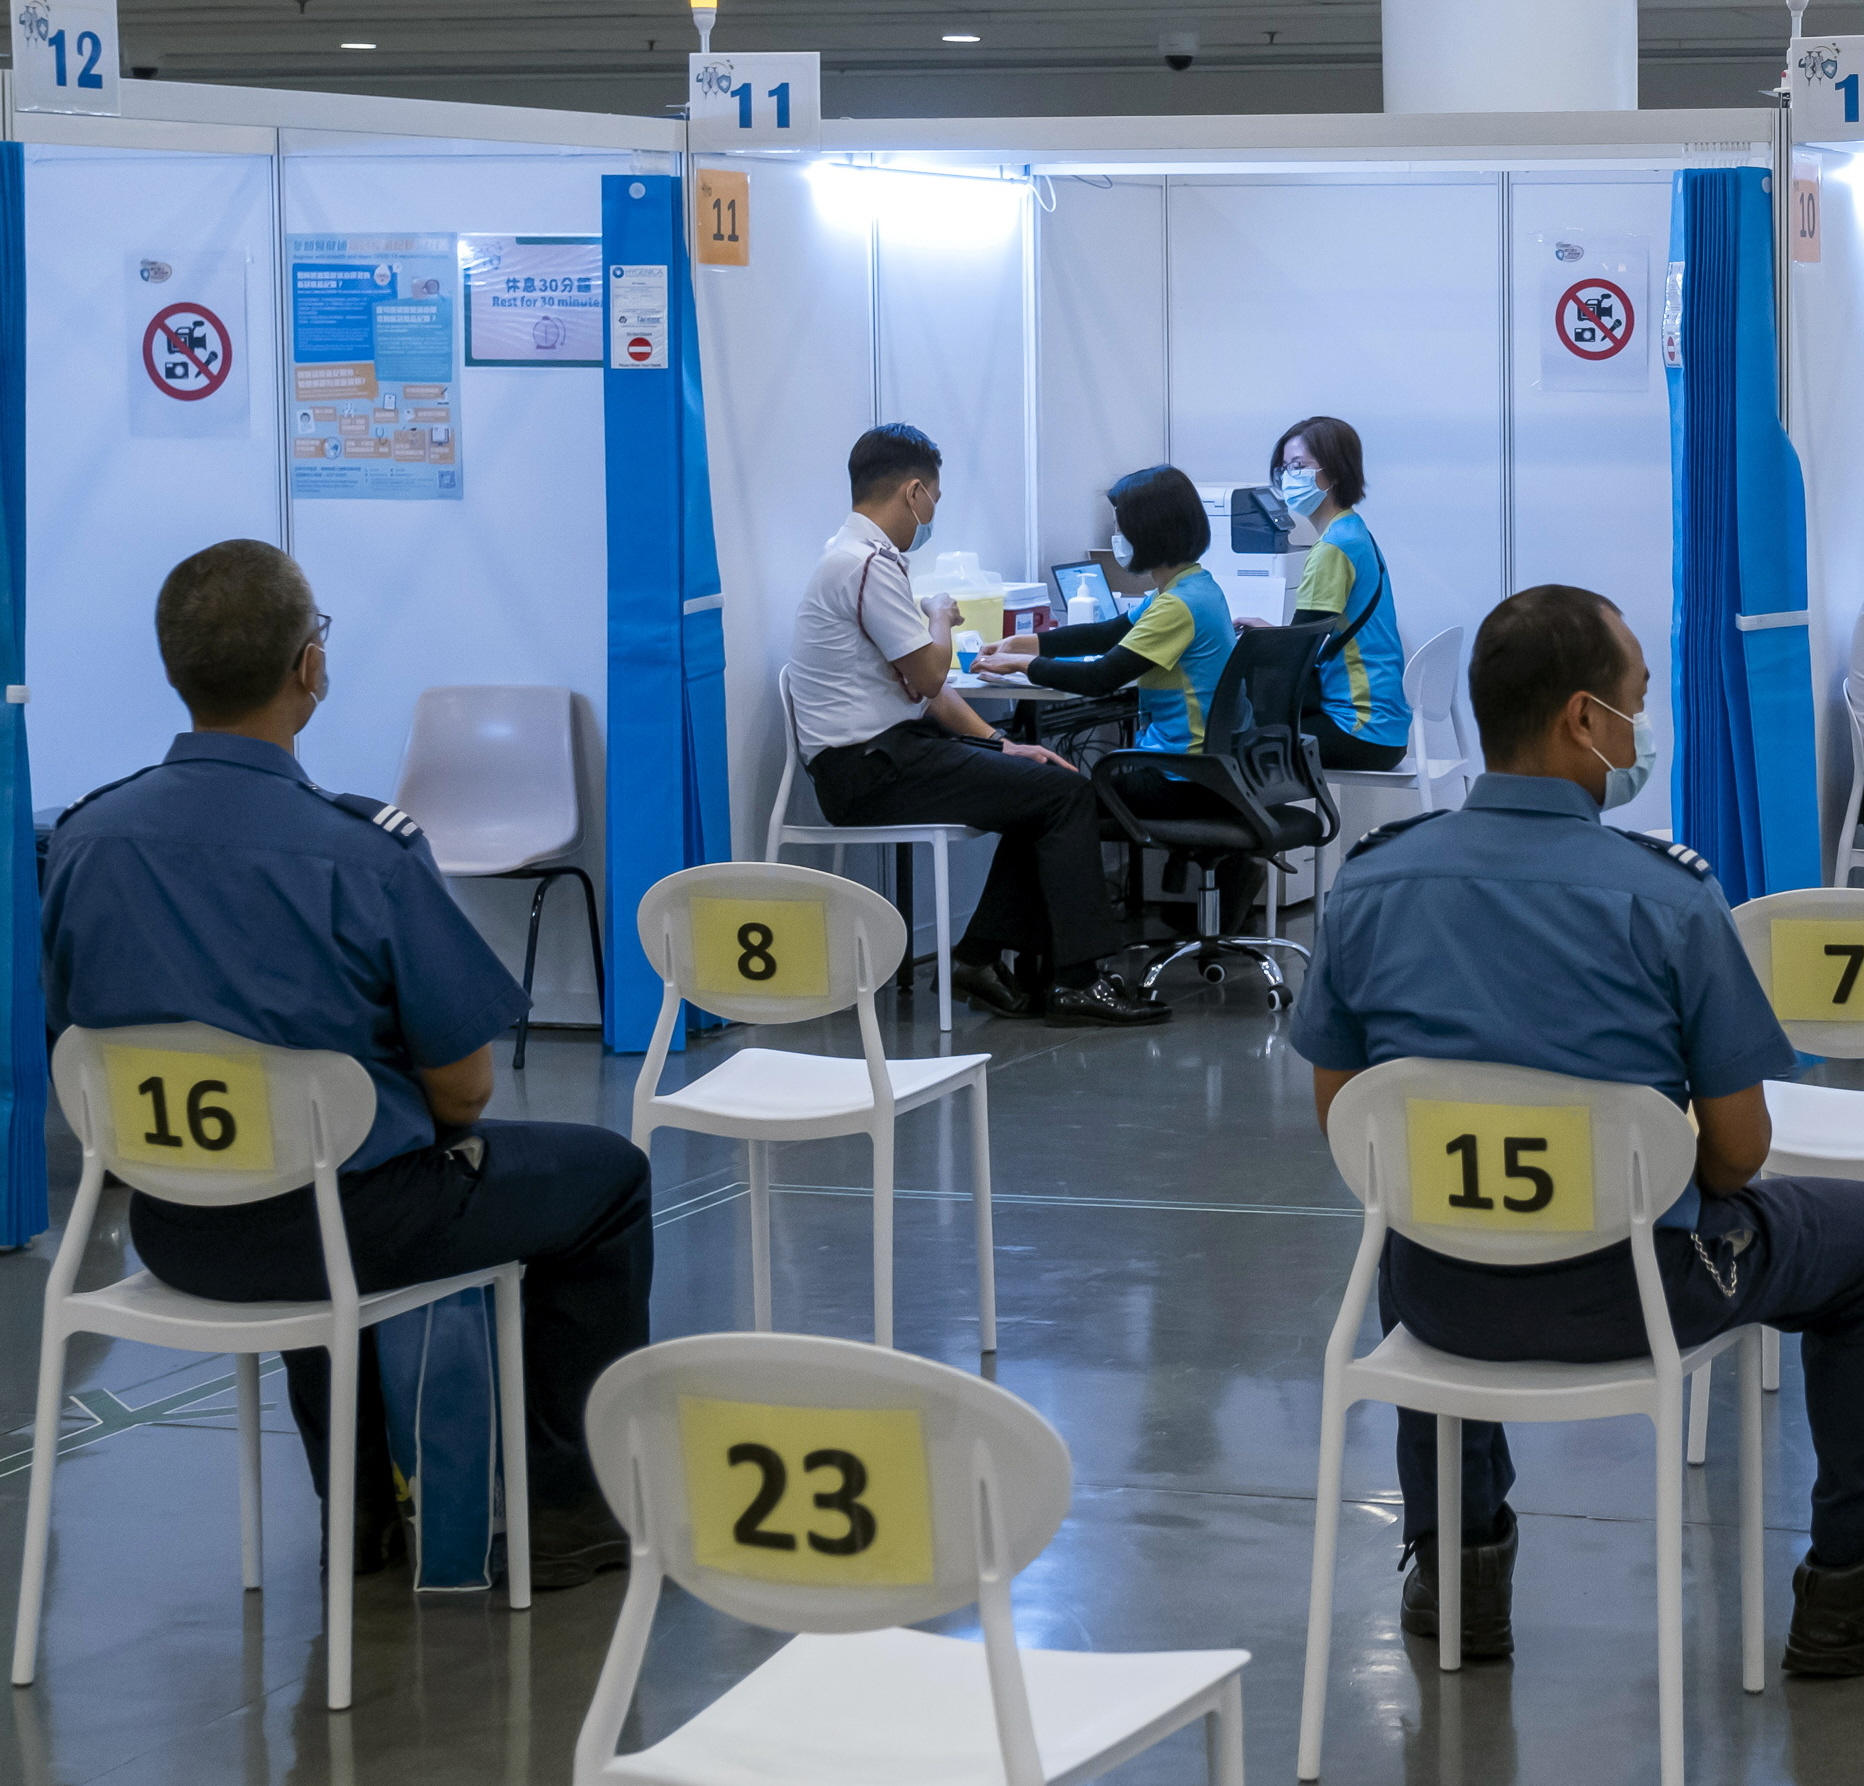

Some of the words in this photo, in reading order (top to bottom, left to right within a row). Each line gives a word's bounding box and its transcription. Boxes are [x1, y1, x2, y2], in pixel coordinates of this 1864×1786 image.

[47, 29, 104, 90] 12
[729, 82, 791, 129] 11
[713, 198, 739, 242] 11
[1799, 191, 1816, 239] 10
[492, 295, 518, 308] Rest
[520, 295, 538, 308] for
[540, 296, 556, 308] 30
[557, 295, 603, 308] minute
[736, 922, 778, 982] 8
[137, 1076, 238, 1152] 16
[1445, 1133, 1555, 1214] 15
[726, 1441, 878, 1557] 23
